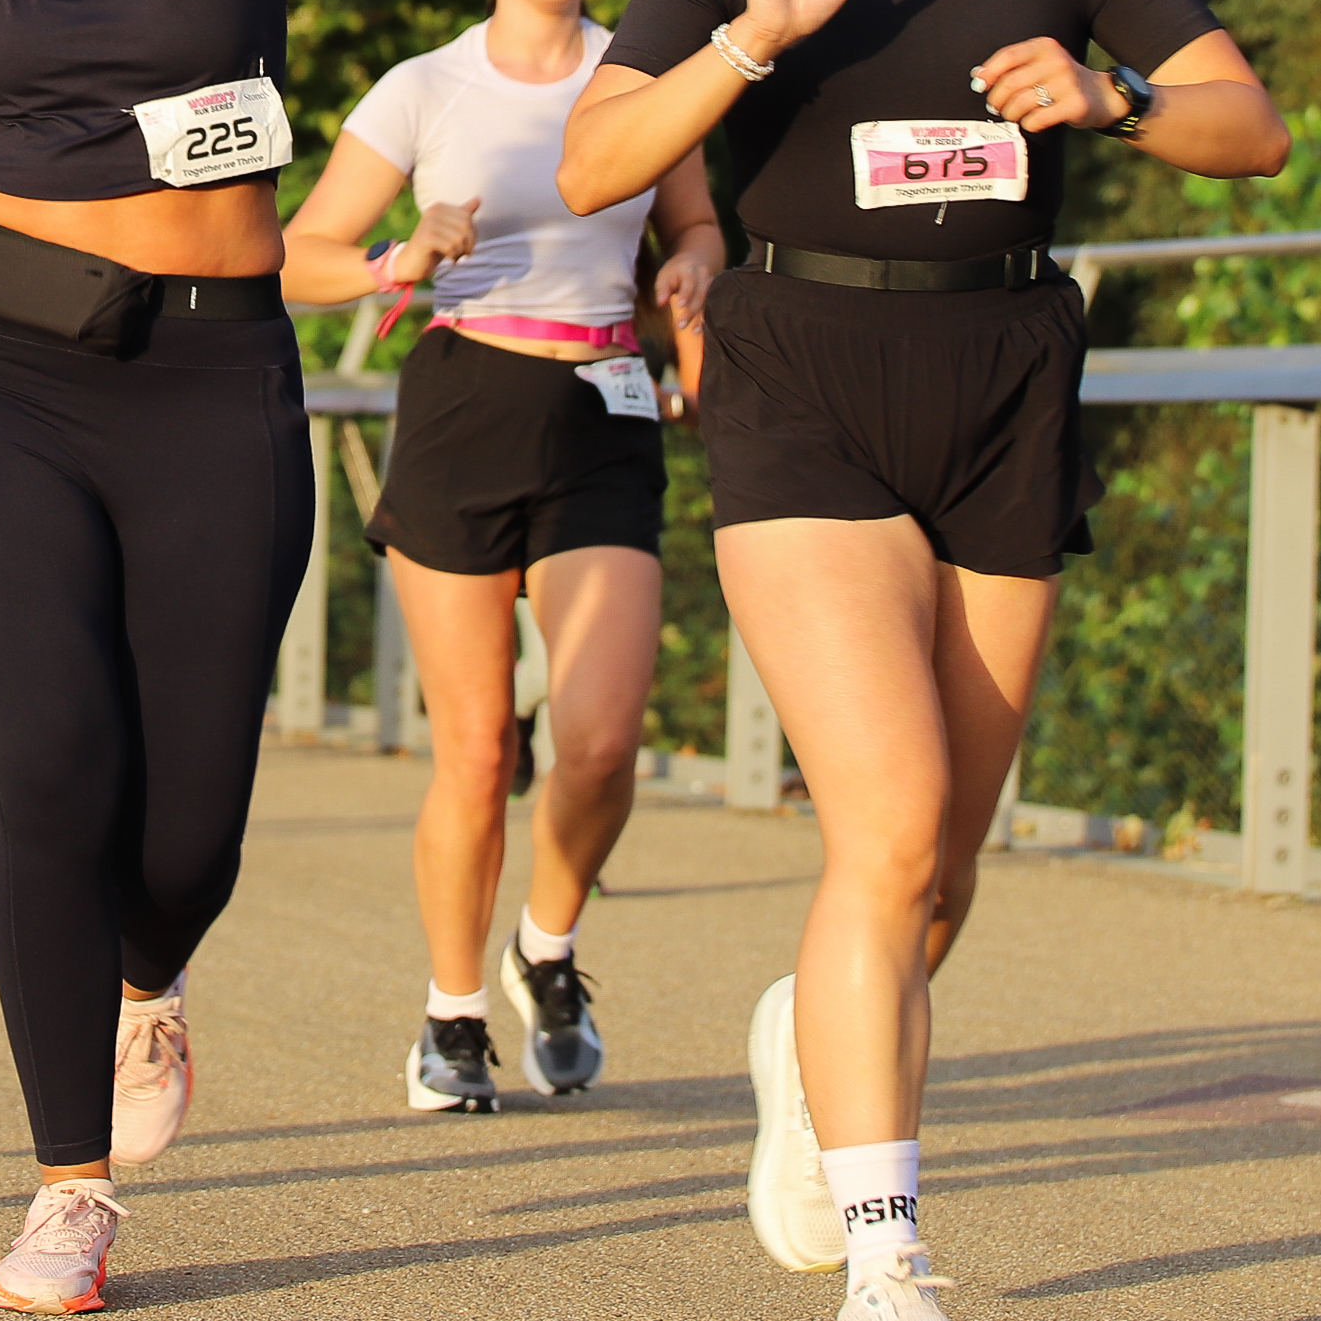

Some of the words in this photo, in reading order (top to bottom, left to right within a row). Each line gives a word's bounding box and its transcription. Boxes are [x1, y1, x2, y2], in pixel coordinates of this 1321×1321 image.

[187, 90, 236, 109] WOMEN'S
[194, 107, 210, 116] RUN
[210, 102, 234, 113] SERIES
[186, 116, 258, 160] 225
[934, 138, 963, 146] SERIES
[182, 164, 222, 178] Together
[223, 161, 236, 170] we
[236, 155, 264, 166] Thrive
[904, 146, 988, 180] 675
[895, 186, 941, 198] Together
